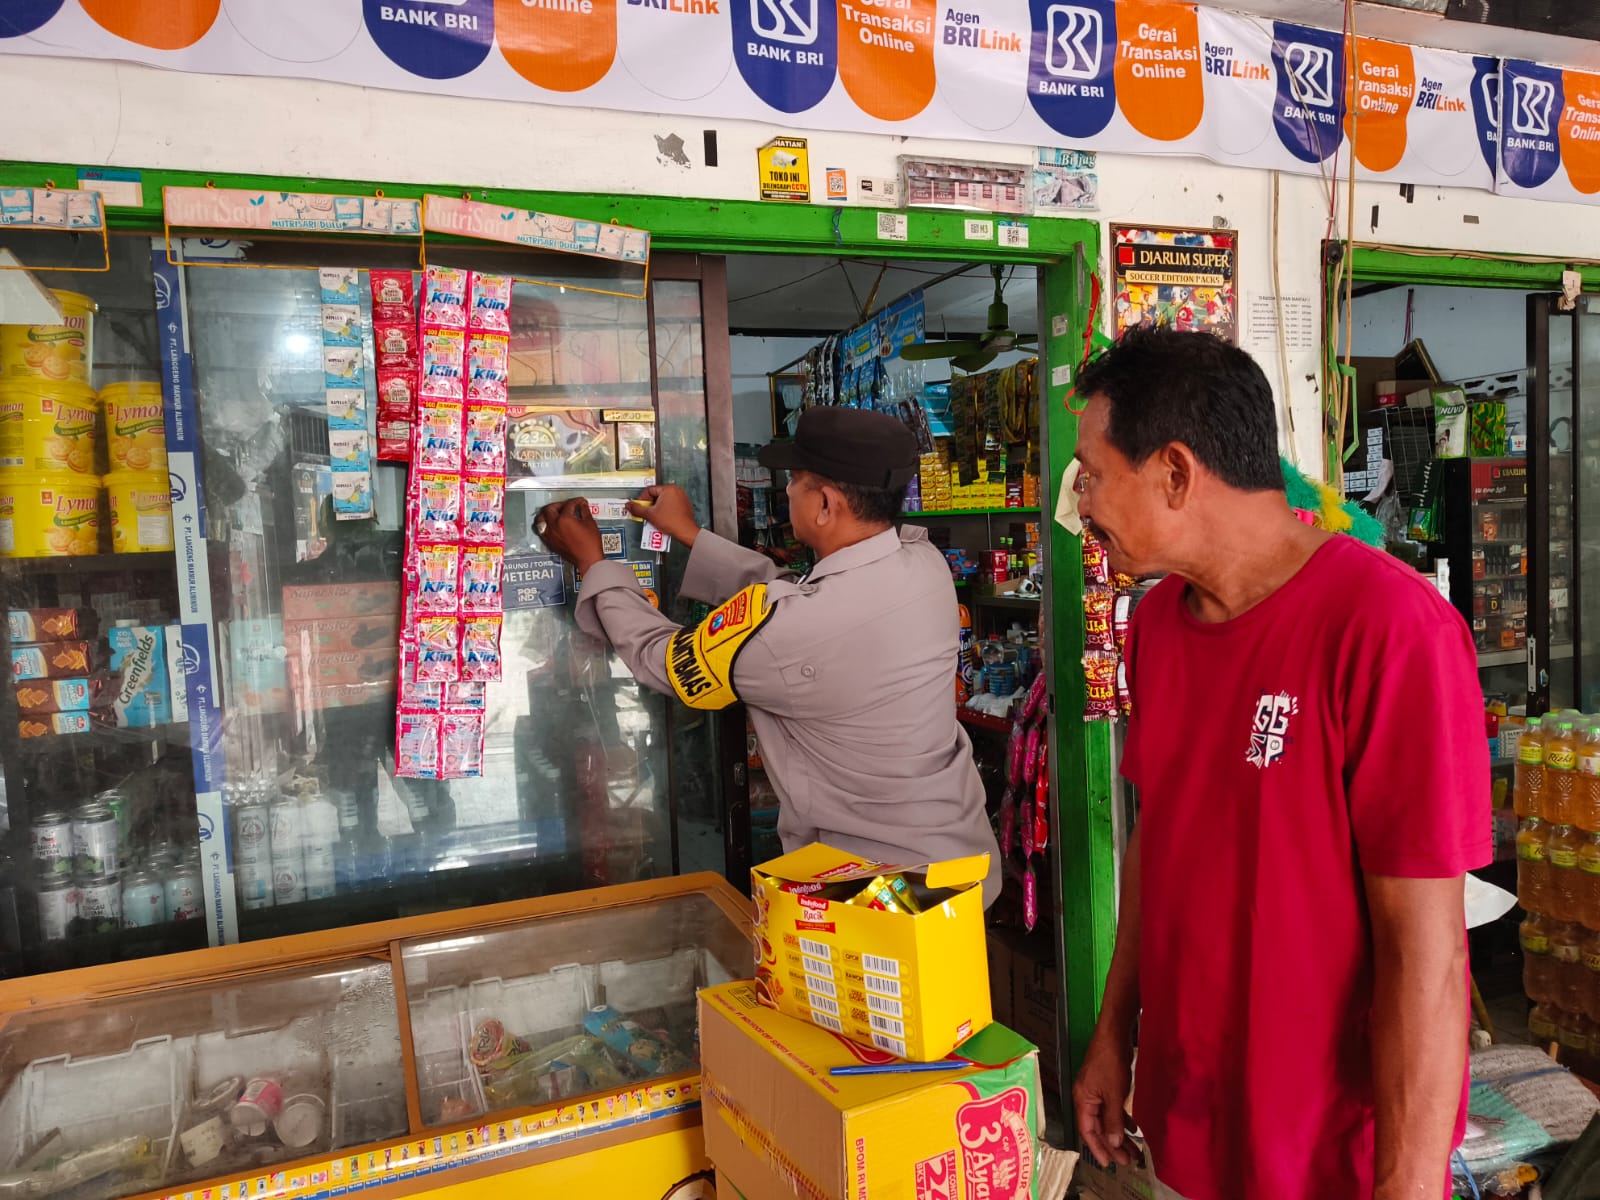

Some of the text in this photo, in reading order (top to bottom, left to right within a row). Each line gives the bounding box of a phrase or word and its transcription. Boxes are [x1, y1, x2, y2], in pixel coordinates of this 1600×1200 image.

[626, 0, 720, 14] Link
[380, 6, 478, 31] BANK BRI
[841, 5, 932, 35] Transaksi
[945, 8, 980, 25] Agen
[859, 27, 916, 53] Online
[943, 24, 1022, 52] BRILink
[1138, 22, 1177, 43] Gerai
[747, 43, 824, 66] BANK BRI
[1121, 40, 1198, 61] Transaksi
[1205, 41, 1233, 56] Agen
[1132, 63, 1186, 79] Online
[1205, 55, 1271, 81] BRILink
[1362, 61, 1399, 78] Gerai
[1039, 81, 1105, 98] BANK BRI
[1421, 77, 1443, 91] Agen
[1360, 94, 1399, 115] Online
[1415, 91, 1468, 112] BRILink
[1577, 94, 1600, 110] Gera
[1283, 105, 1336, 125] BANK BRI
[1565, 106, 1600, 124] Transa
[1486, 131, 1498, 143] BA
[1570, 125, 1600, 141] Onlin
[1507, 137, 1555, 152] BANK BRI
[769, 171, 800, 183] TOKO INI
[791, 183, 807, 191] CCTV
[272, 219, 317, 230] NUTRISARI
[516, 235, 558, 249] NUTRISARI
[1140, 250, 1230, 269] DJARUM SUPER
[1130, 273, 1221, 285] SOCCER EDITION PACKS
[476, 296, 506, 311] Klin
[428, 364, 458, 378] Klin
[509, 451, 562, 460] MAGNUM
[652, 532, 662, 548] 110
[502, 568, 554, 583] METERAI
[468, 581, 497, 593] Klin
[517, 587, 538, 596] POS
[518, 594, 535, 602] IND
[423, 650, 452, 662] Klin
[119, 634, 153, 705] Greenfields
[803, 910, 825, 921] Racik
[960, 1121, 1002, 1149] 3
[1002, 1136, 1010, 1152] CAP
[855, 1138, 866, 1170] BPOM
[1016, 1128, 1030, 1189] MI TELUR
[858, 1173, 867, 1184] RI
[972, 1151, 994, 1200] Aya
